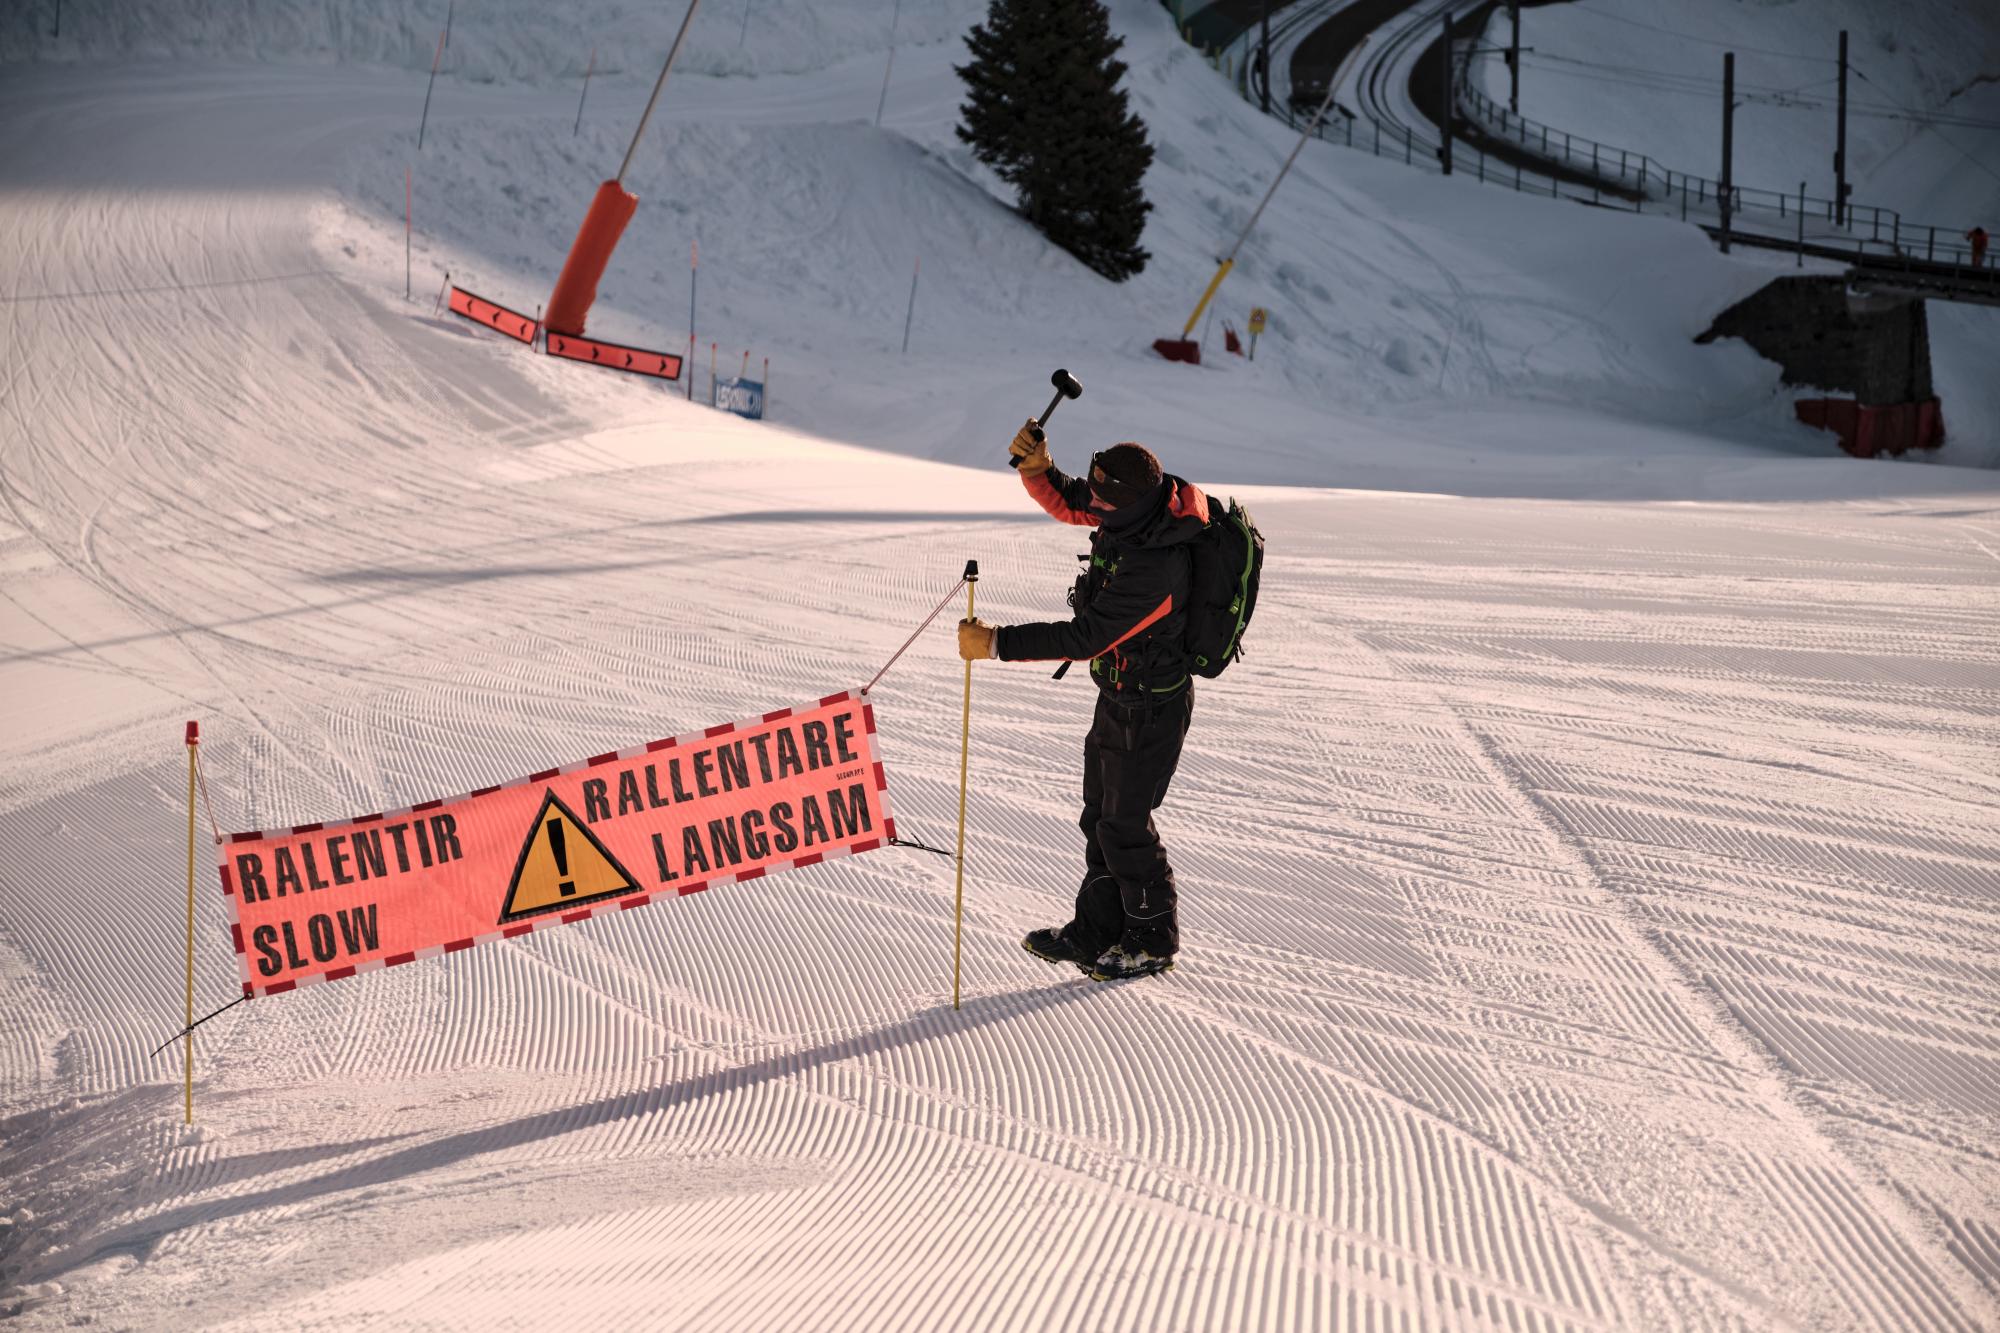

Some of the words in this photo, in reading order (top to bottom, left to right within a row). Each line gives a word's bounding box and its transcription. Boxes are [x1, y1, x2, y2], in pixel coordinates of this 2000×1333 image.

[582, 712, 859, 824] RALLENTARE
[236, 813, 463, 904] RALENTIR
[651, 783, 872, 882] LANGSAM
[253, 903, 379, 976] SLOW
